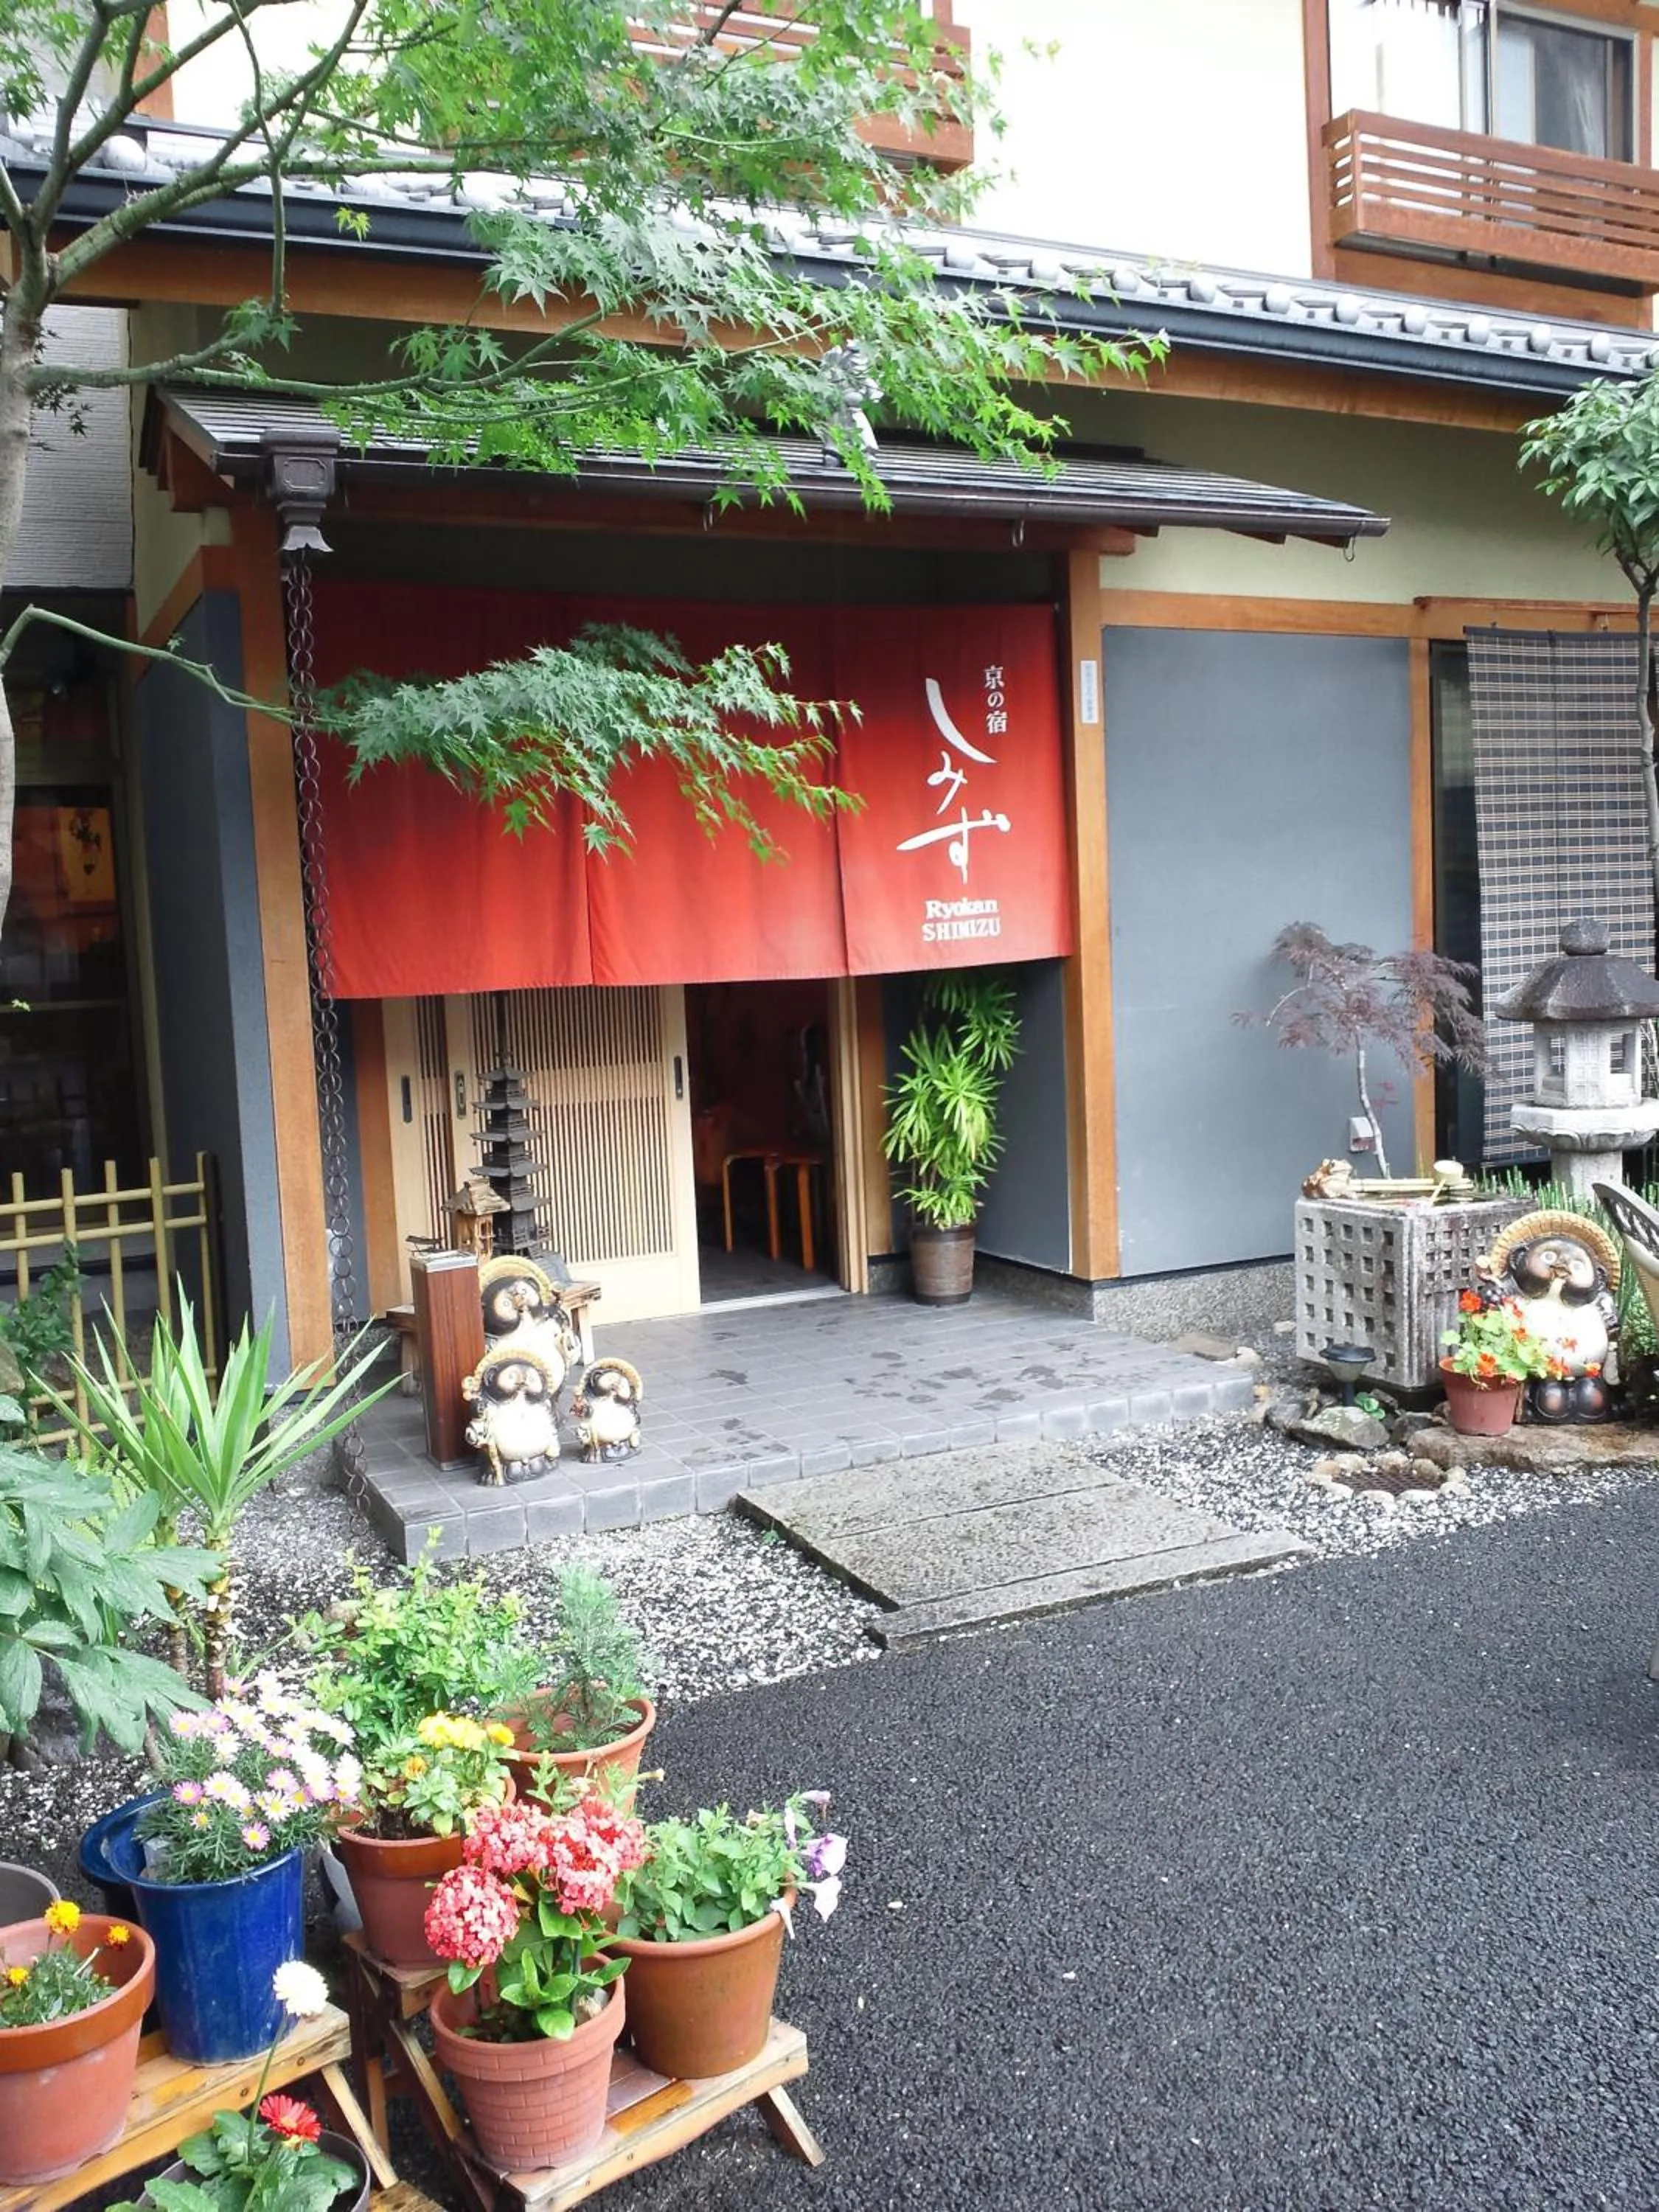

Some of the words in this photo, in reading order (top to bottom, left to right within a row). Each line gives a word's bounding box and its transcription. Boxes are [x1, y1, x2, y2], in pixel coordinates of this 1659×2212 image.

[984, 665, 1008, 734] 京の宿
[925, 897, 998, 920] Ryokan
[922, 917, 1000, 942] SHIMIZU
